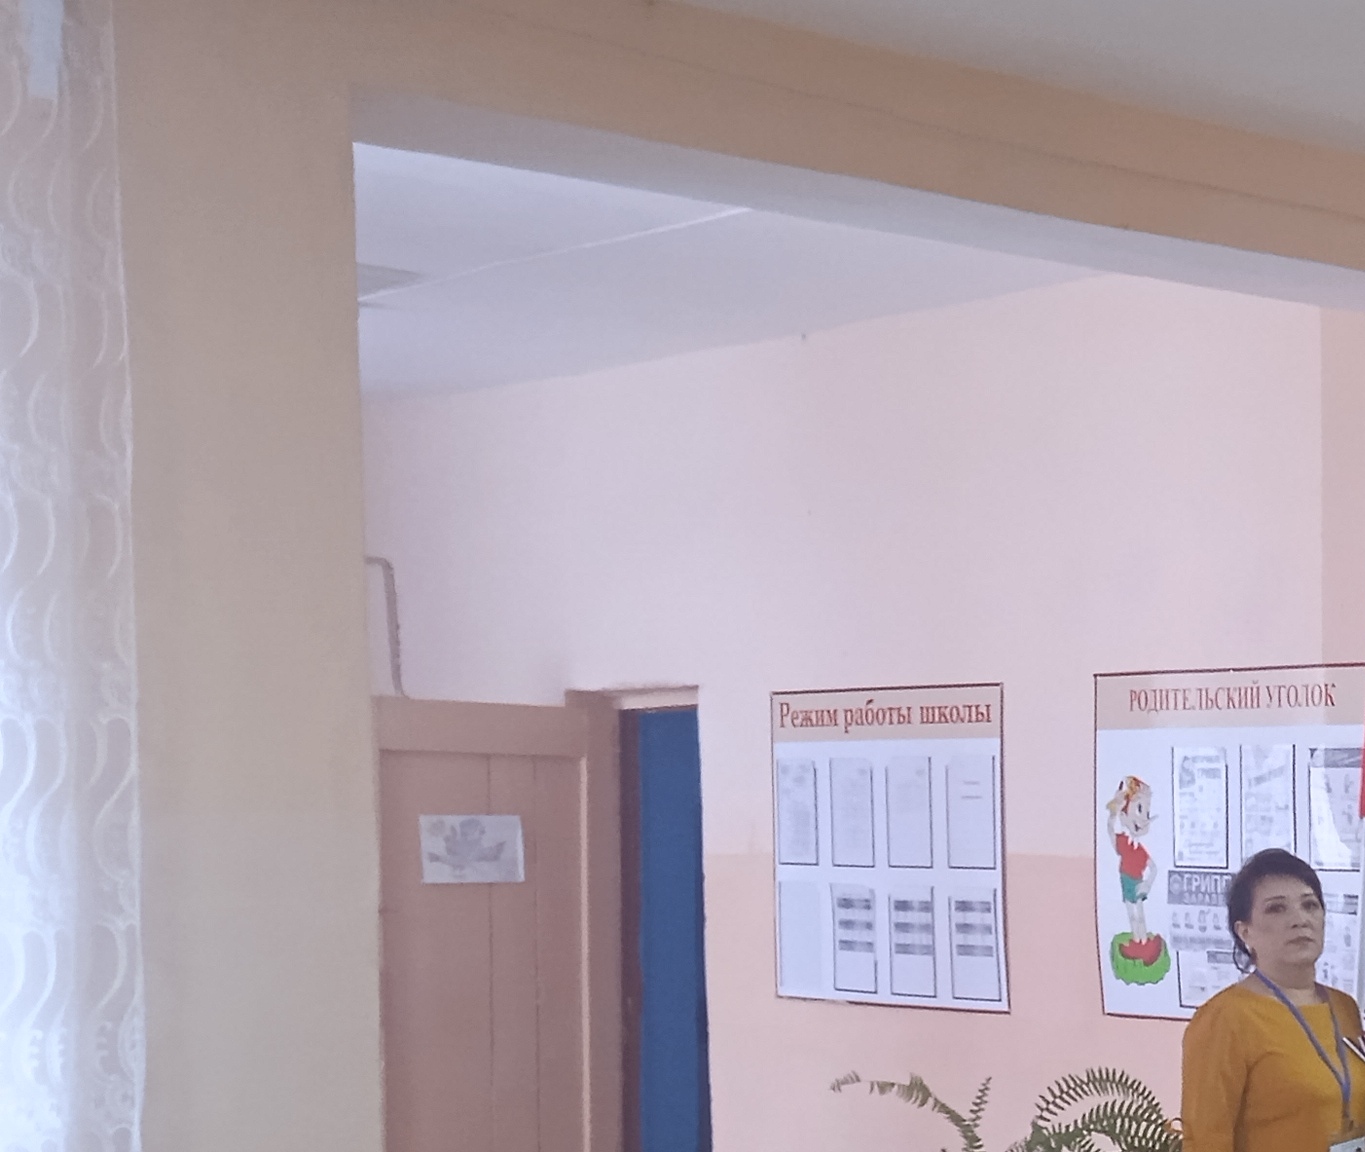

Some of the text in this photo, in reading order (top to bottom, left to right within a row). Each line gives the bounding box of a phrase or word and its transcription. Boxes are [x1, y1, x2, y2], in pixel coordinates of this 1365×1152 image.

[1129, 680, 1337, 713] РОДИТЕЛЬСКИЙ УГОЛОК
[779, 699, 992, 733] Режим работы школы
